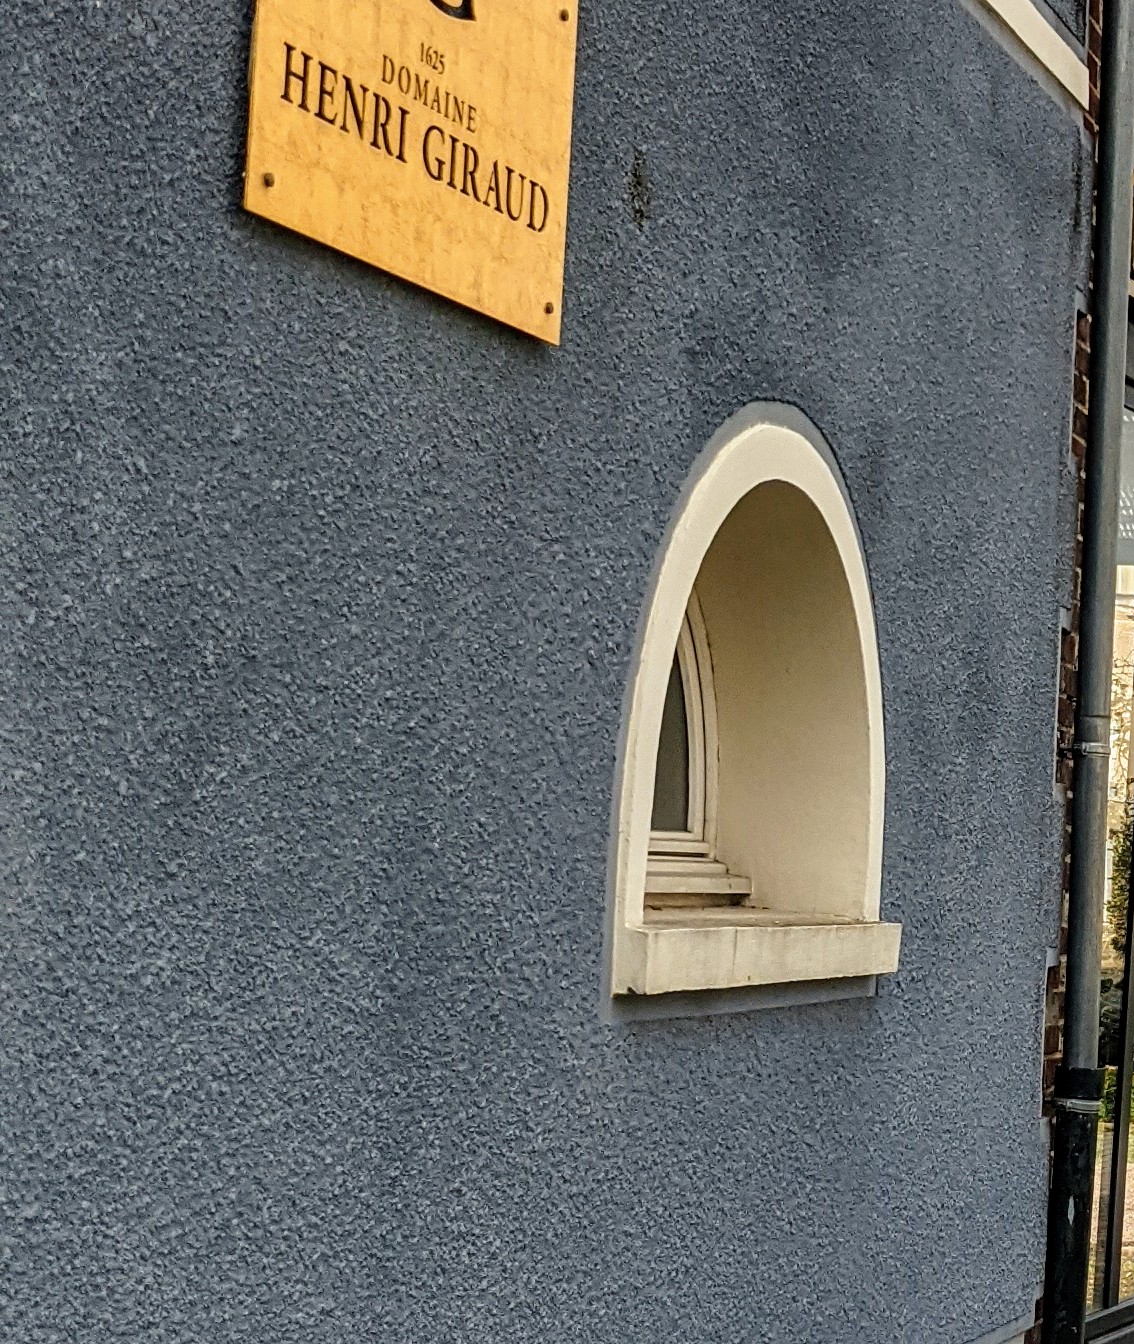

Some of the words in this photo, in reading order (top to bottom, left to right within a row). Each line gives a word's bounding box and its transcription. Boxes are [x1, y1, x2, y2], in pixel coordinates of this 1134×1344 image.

[382, 54, 477, 133] DOMAINE
[420, 42, 445, 75] 1625
[280, 41, 410, 164] HENRI
[422, 125, 549, 233] GIRAUD
